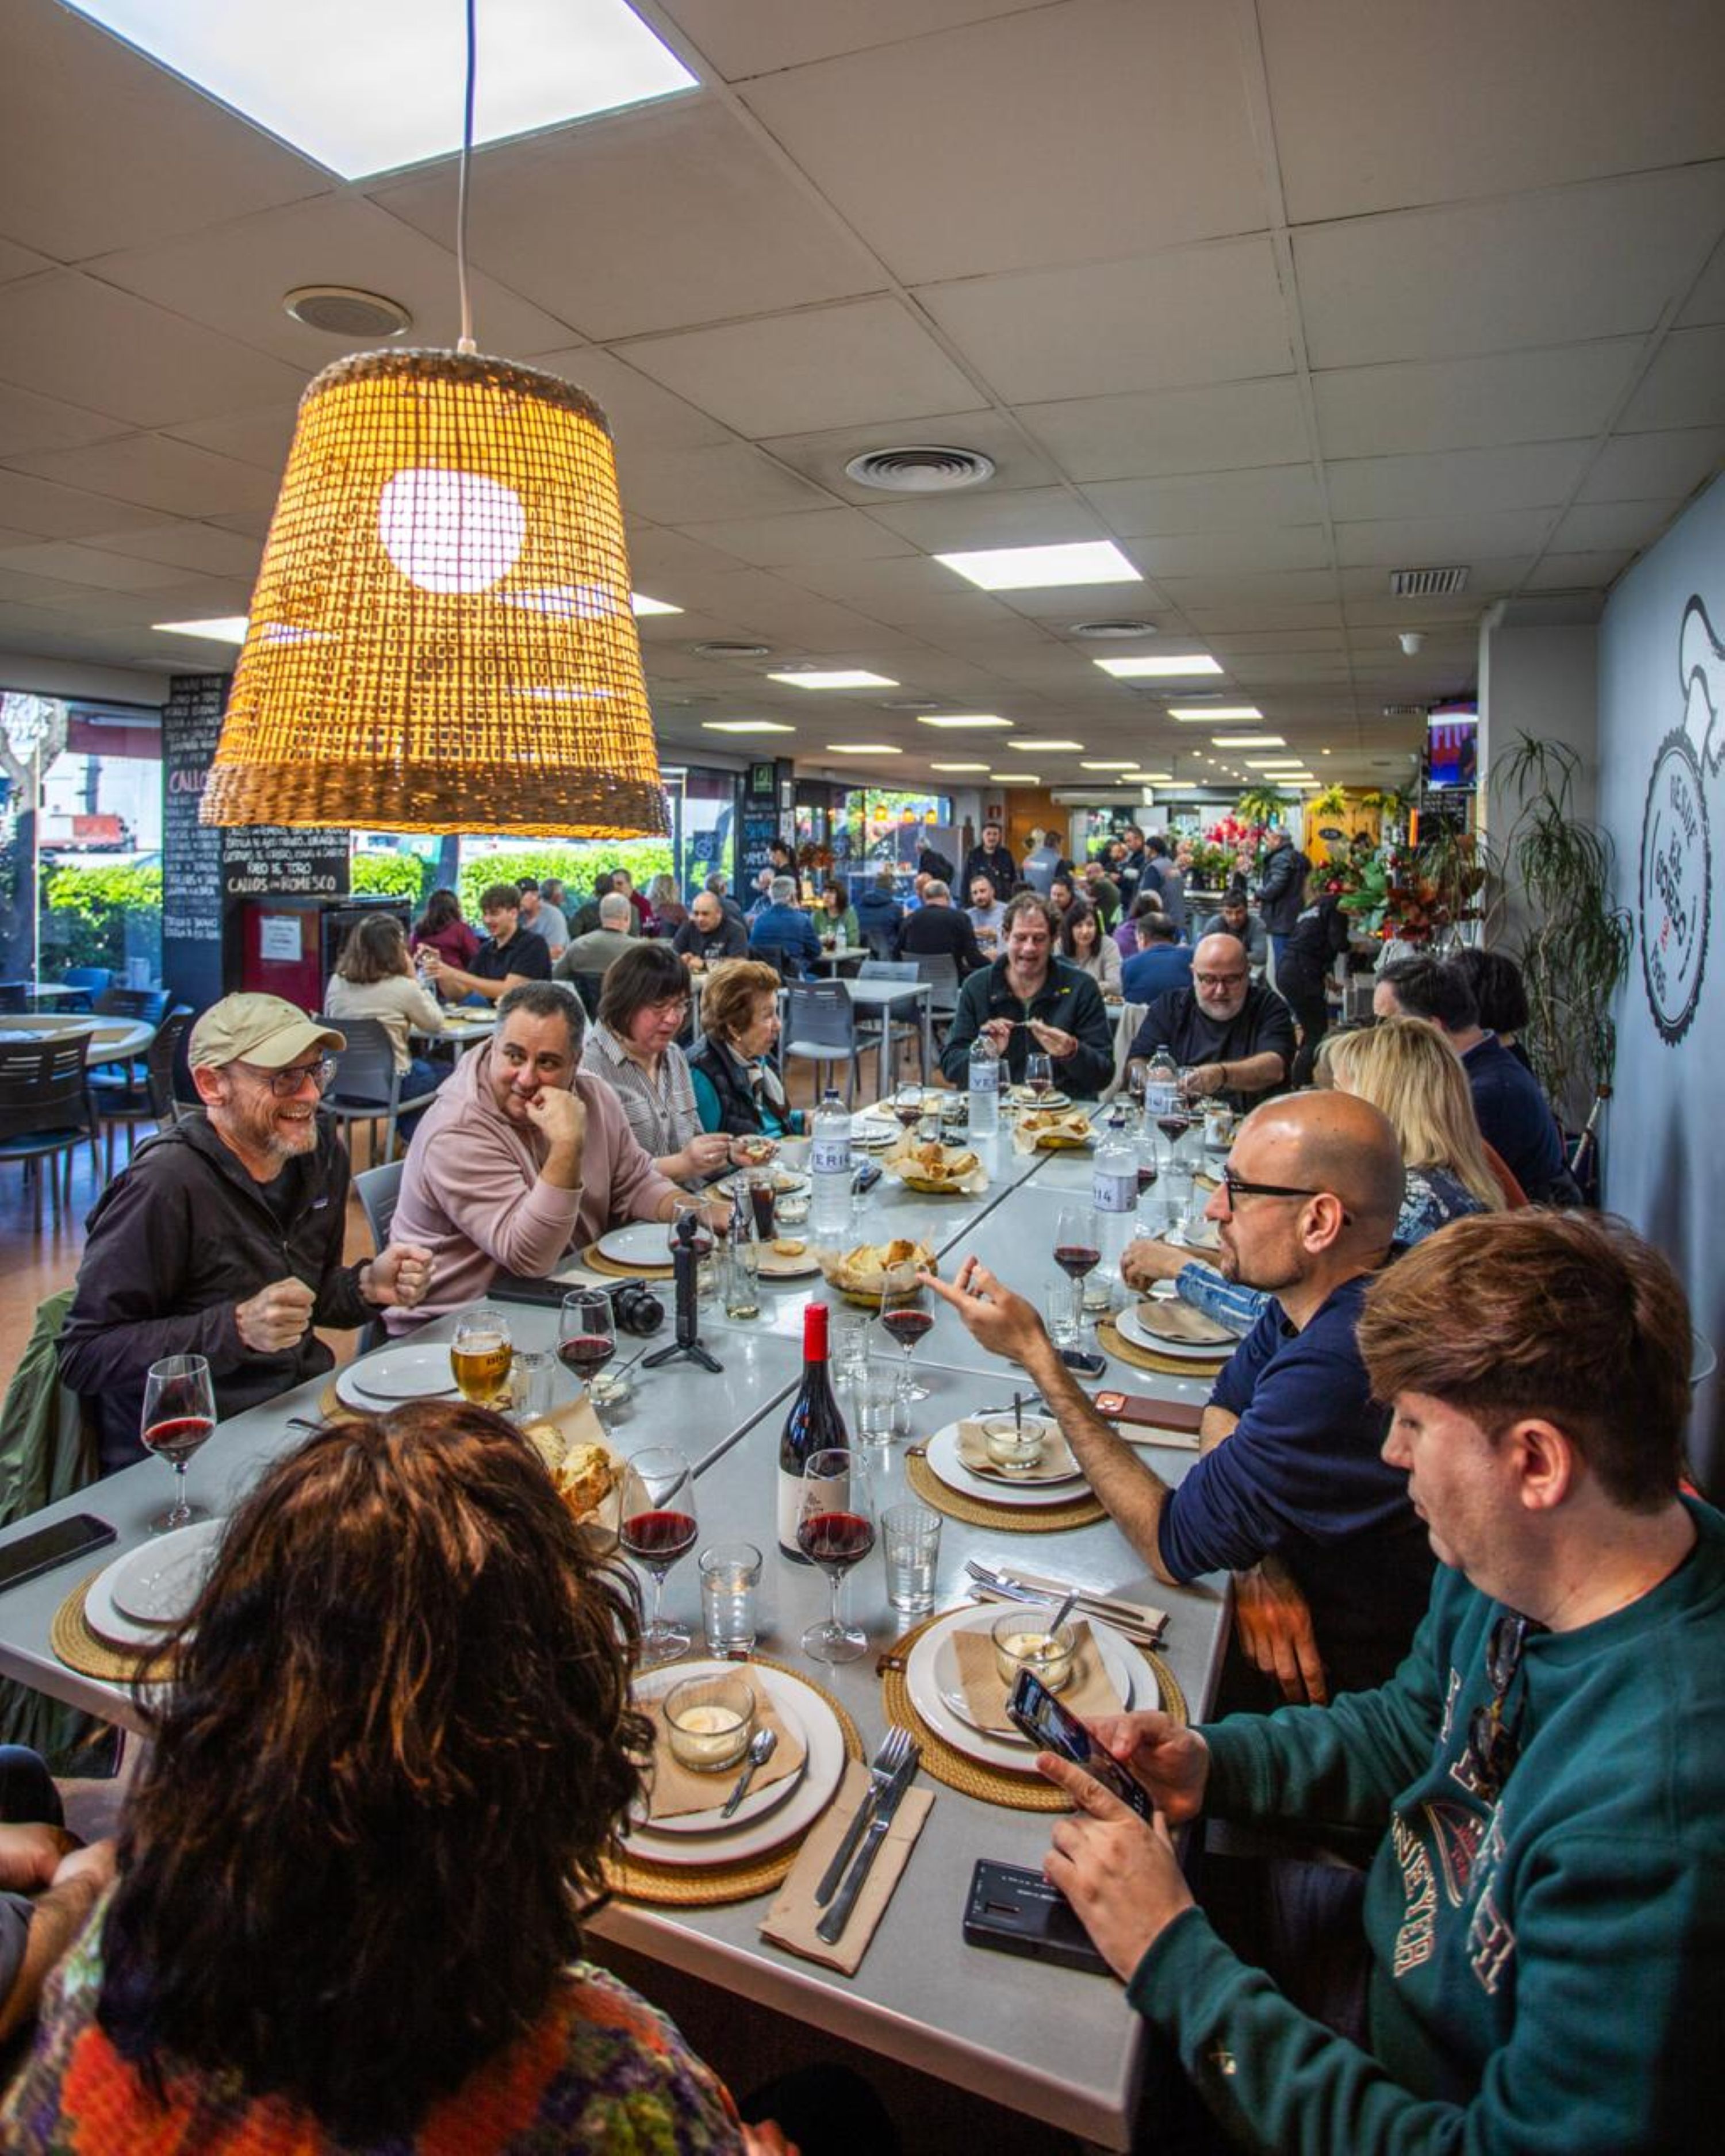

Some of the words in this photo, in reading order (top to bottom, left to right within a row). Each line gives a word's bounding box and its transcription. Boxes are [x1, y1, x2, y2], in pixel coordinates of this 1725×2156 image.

[169, 769, 209, 793] CALLO
[284, 862, 312, 874] TORO
[228, 876, 269, 892] CALLOS
[281, 874, 336, 891] ROMESCO
